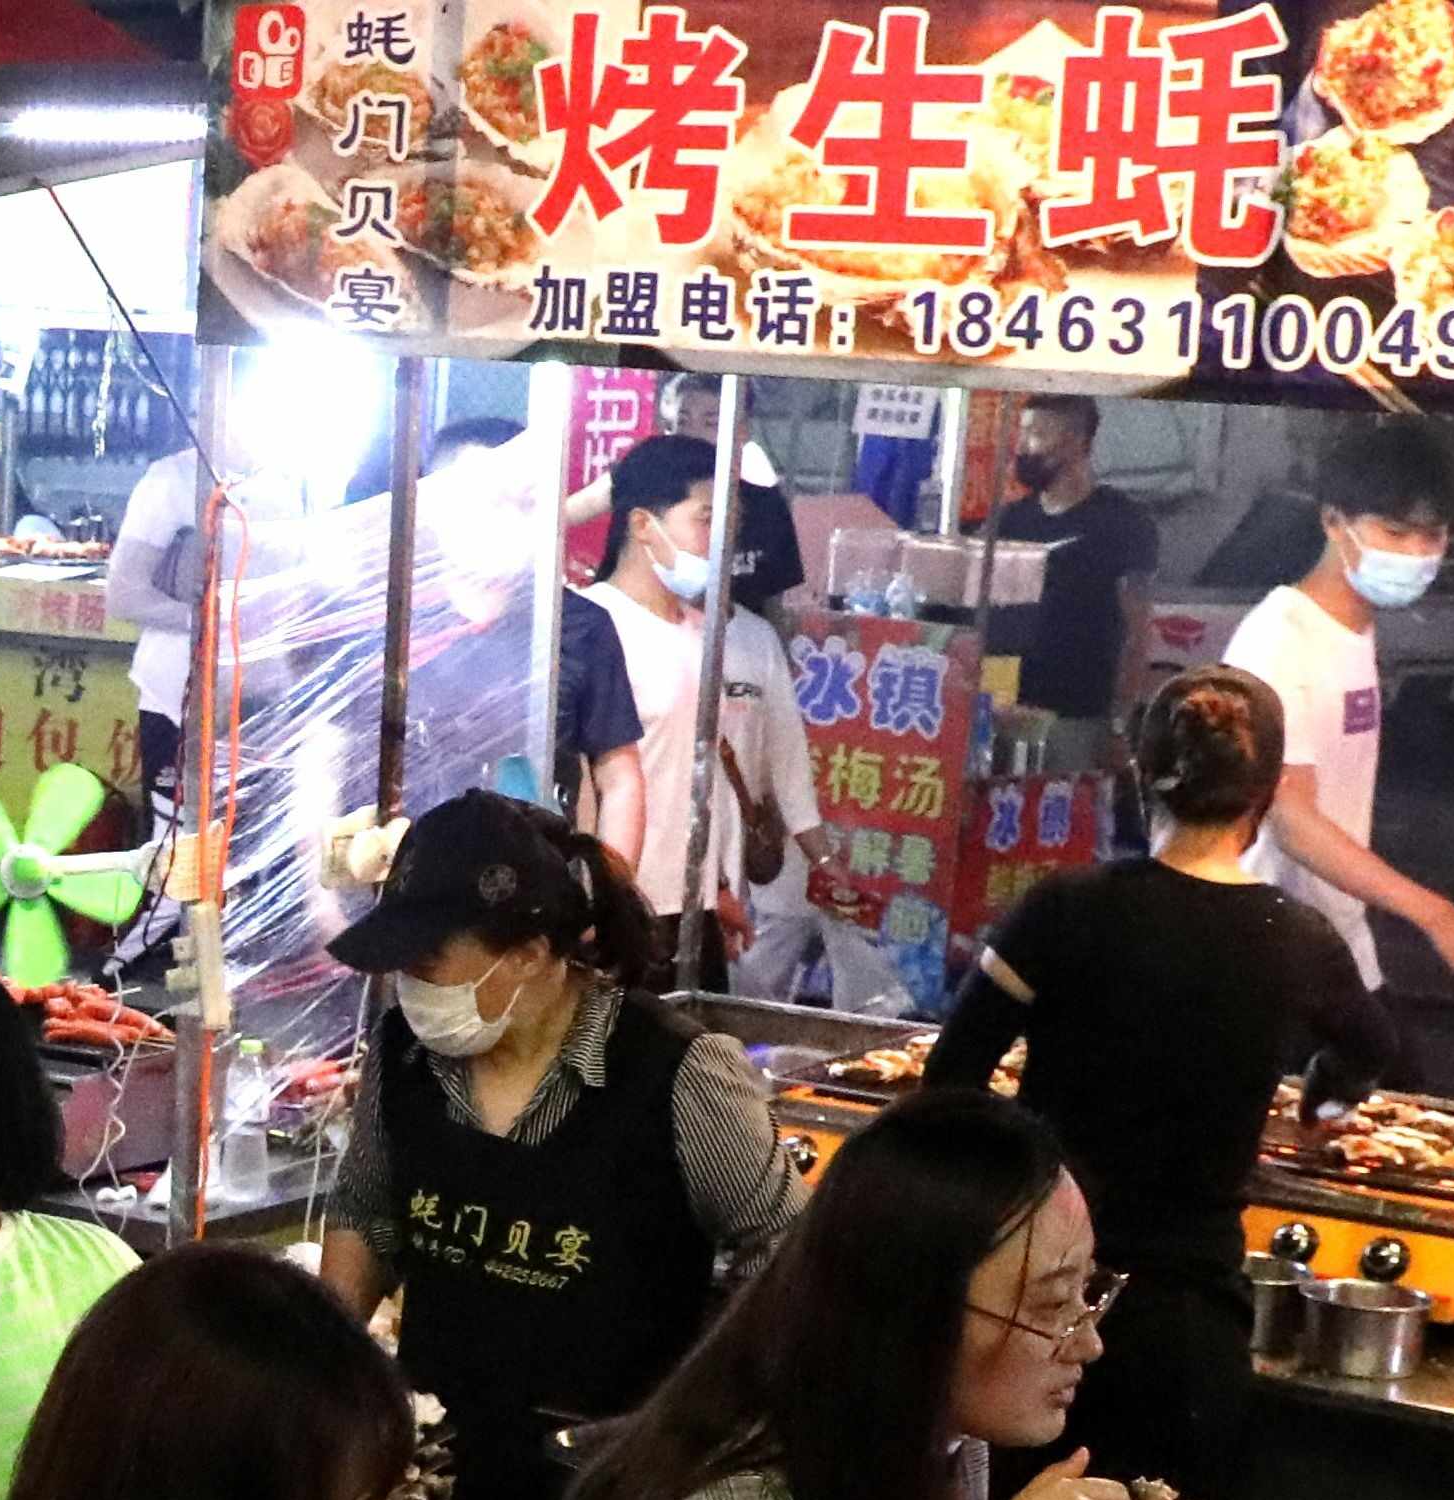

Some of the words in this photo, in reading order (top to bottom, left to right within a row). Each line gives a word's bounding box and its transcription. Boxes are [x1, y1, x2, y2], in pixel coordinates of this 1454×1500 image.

[332, 11, 416, 325] 蚝门贝宴
[532, 8, 1286, 264] 烤生蚝
[793, 637, 946, 738] 冰镇
[810, 747, 944, 818] 梅汤
[409, 1188, 591, 1273] 蚝门贝宴
